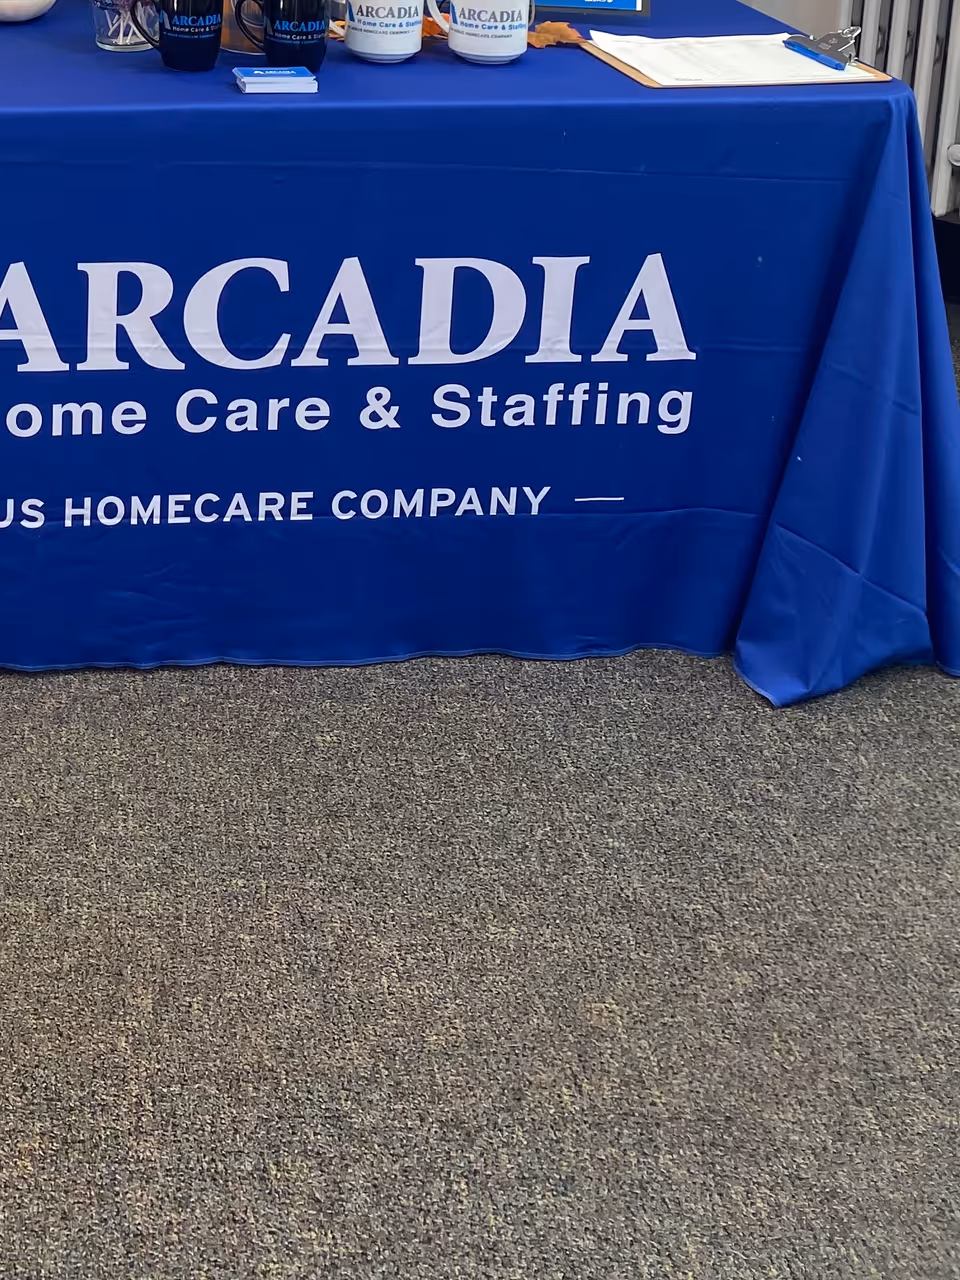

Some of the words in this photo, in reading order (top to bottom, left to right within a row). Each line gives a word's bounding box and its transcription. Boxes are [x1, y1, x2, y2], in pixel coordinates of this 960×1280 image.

[356, 4, 419, 19] ARCADIA
[458, 7, 523, 23] ARCADIA
[172, 13, 222, 26] ARCADIA
[273, 19, 327, 32] ARCADIA
[357, 19, 377, 27] Home
[460, 20, 479, 29] Home
[176, 389, 331, 434] Care
[359, 386, 401, 430] &
[432, 382, 693, 434] Staffing
[64, 491, 314, 529] HOMECARE
[331, 486, 550, 520] COMPANY
